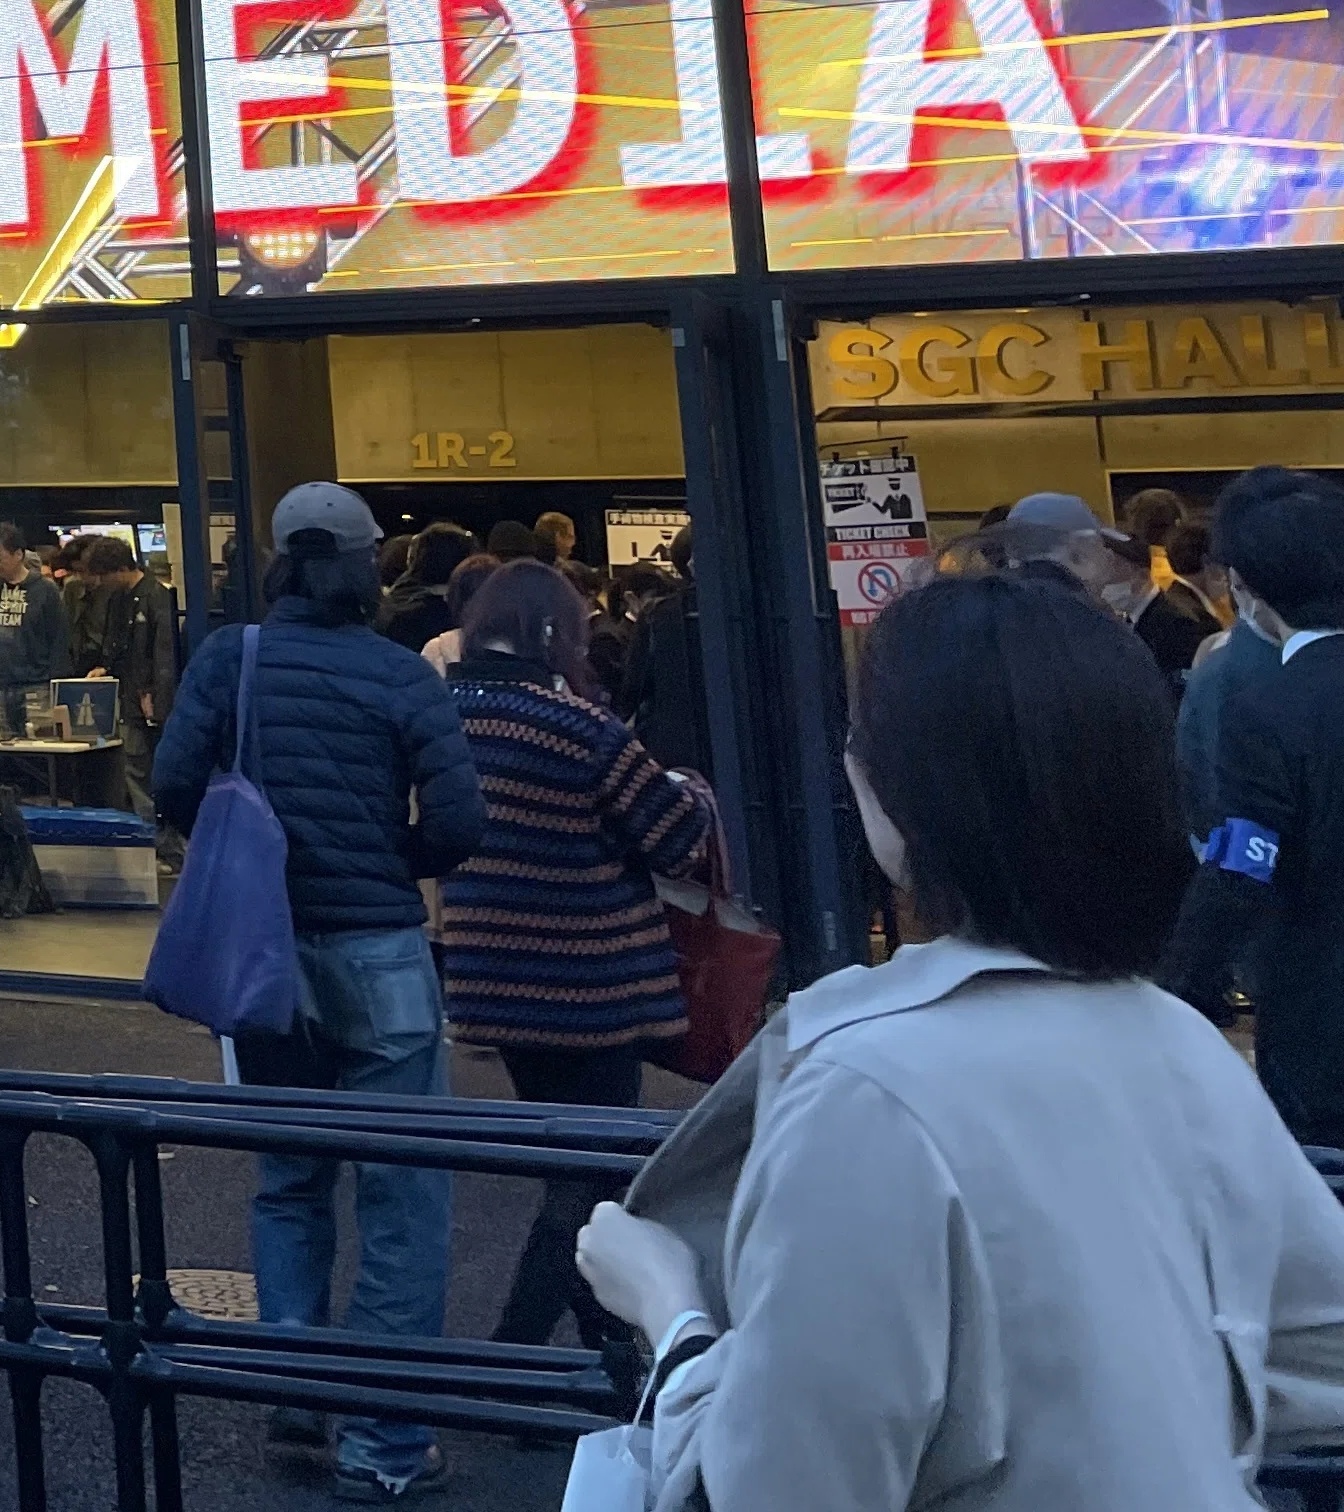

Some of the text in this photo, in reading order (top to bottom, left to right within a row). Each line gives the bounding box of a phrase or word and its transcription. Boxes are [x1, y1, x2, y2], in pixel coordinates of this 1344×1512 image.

[828, 314, 1344, 400] SGC HALL
[411, 430, 518, 470] 1R-2
